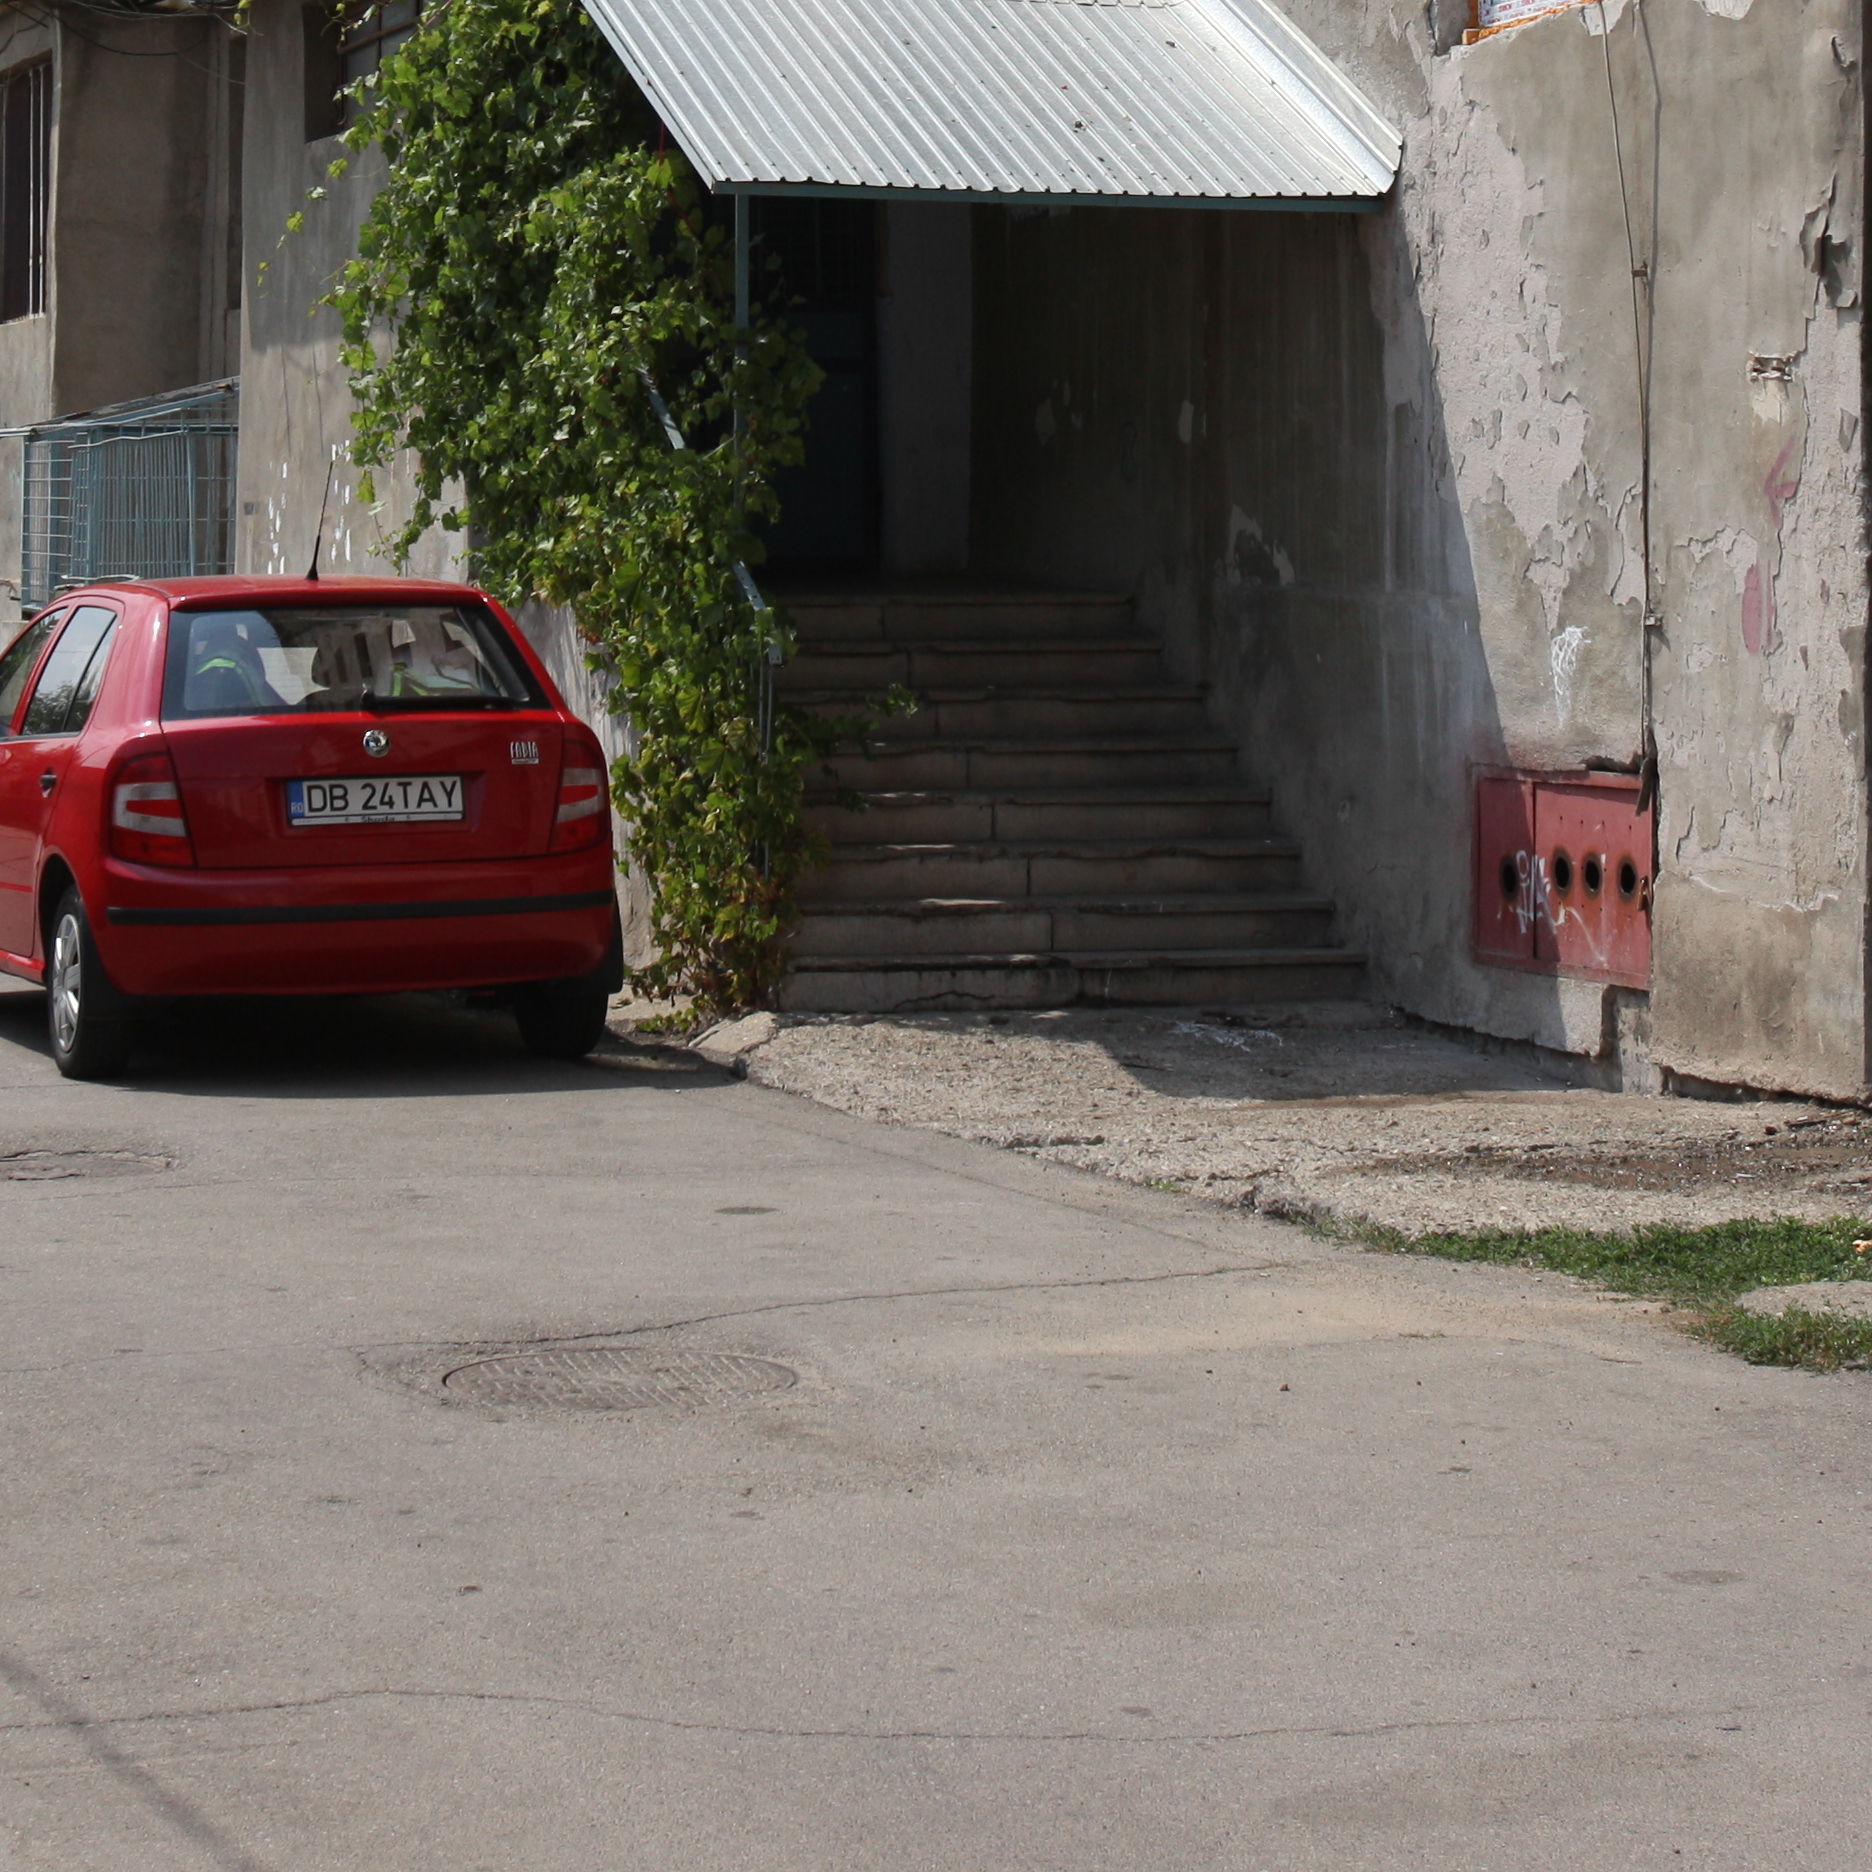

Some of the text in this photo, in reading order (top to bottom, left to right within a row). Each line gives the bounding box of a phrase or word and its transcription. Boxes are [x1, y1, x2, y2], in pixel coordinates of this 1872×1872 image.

[510, 741, 539, 758] FABIA
[306, 780, 458, 813] DB 24TAY
